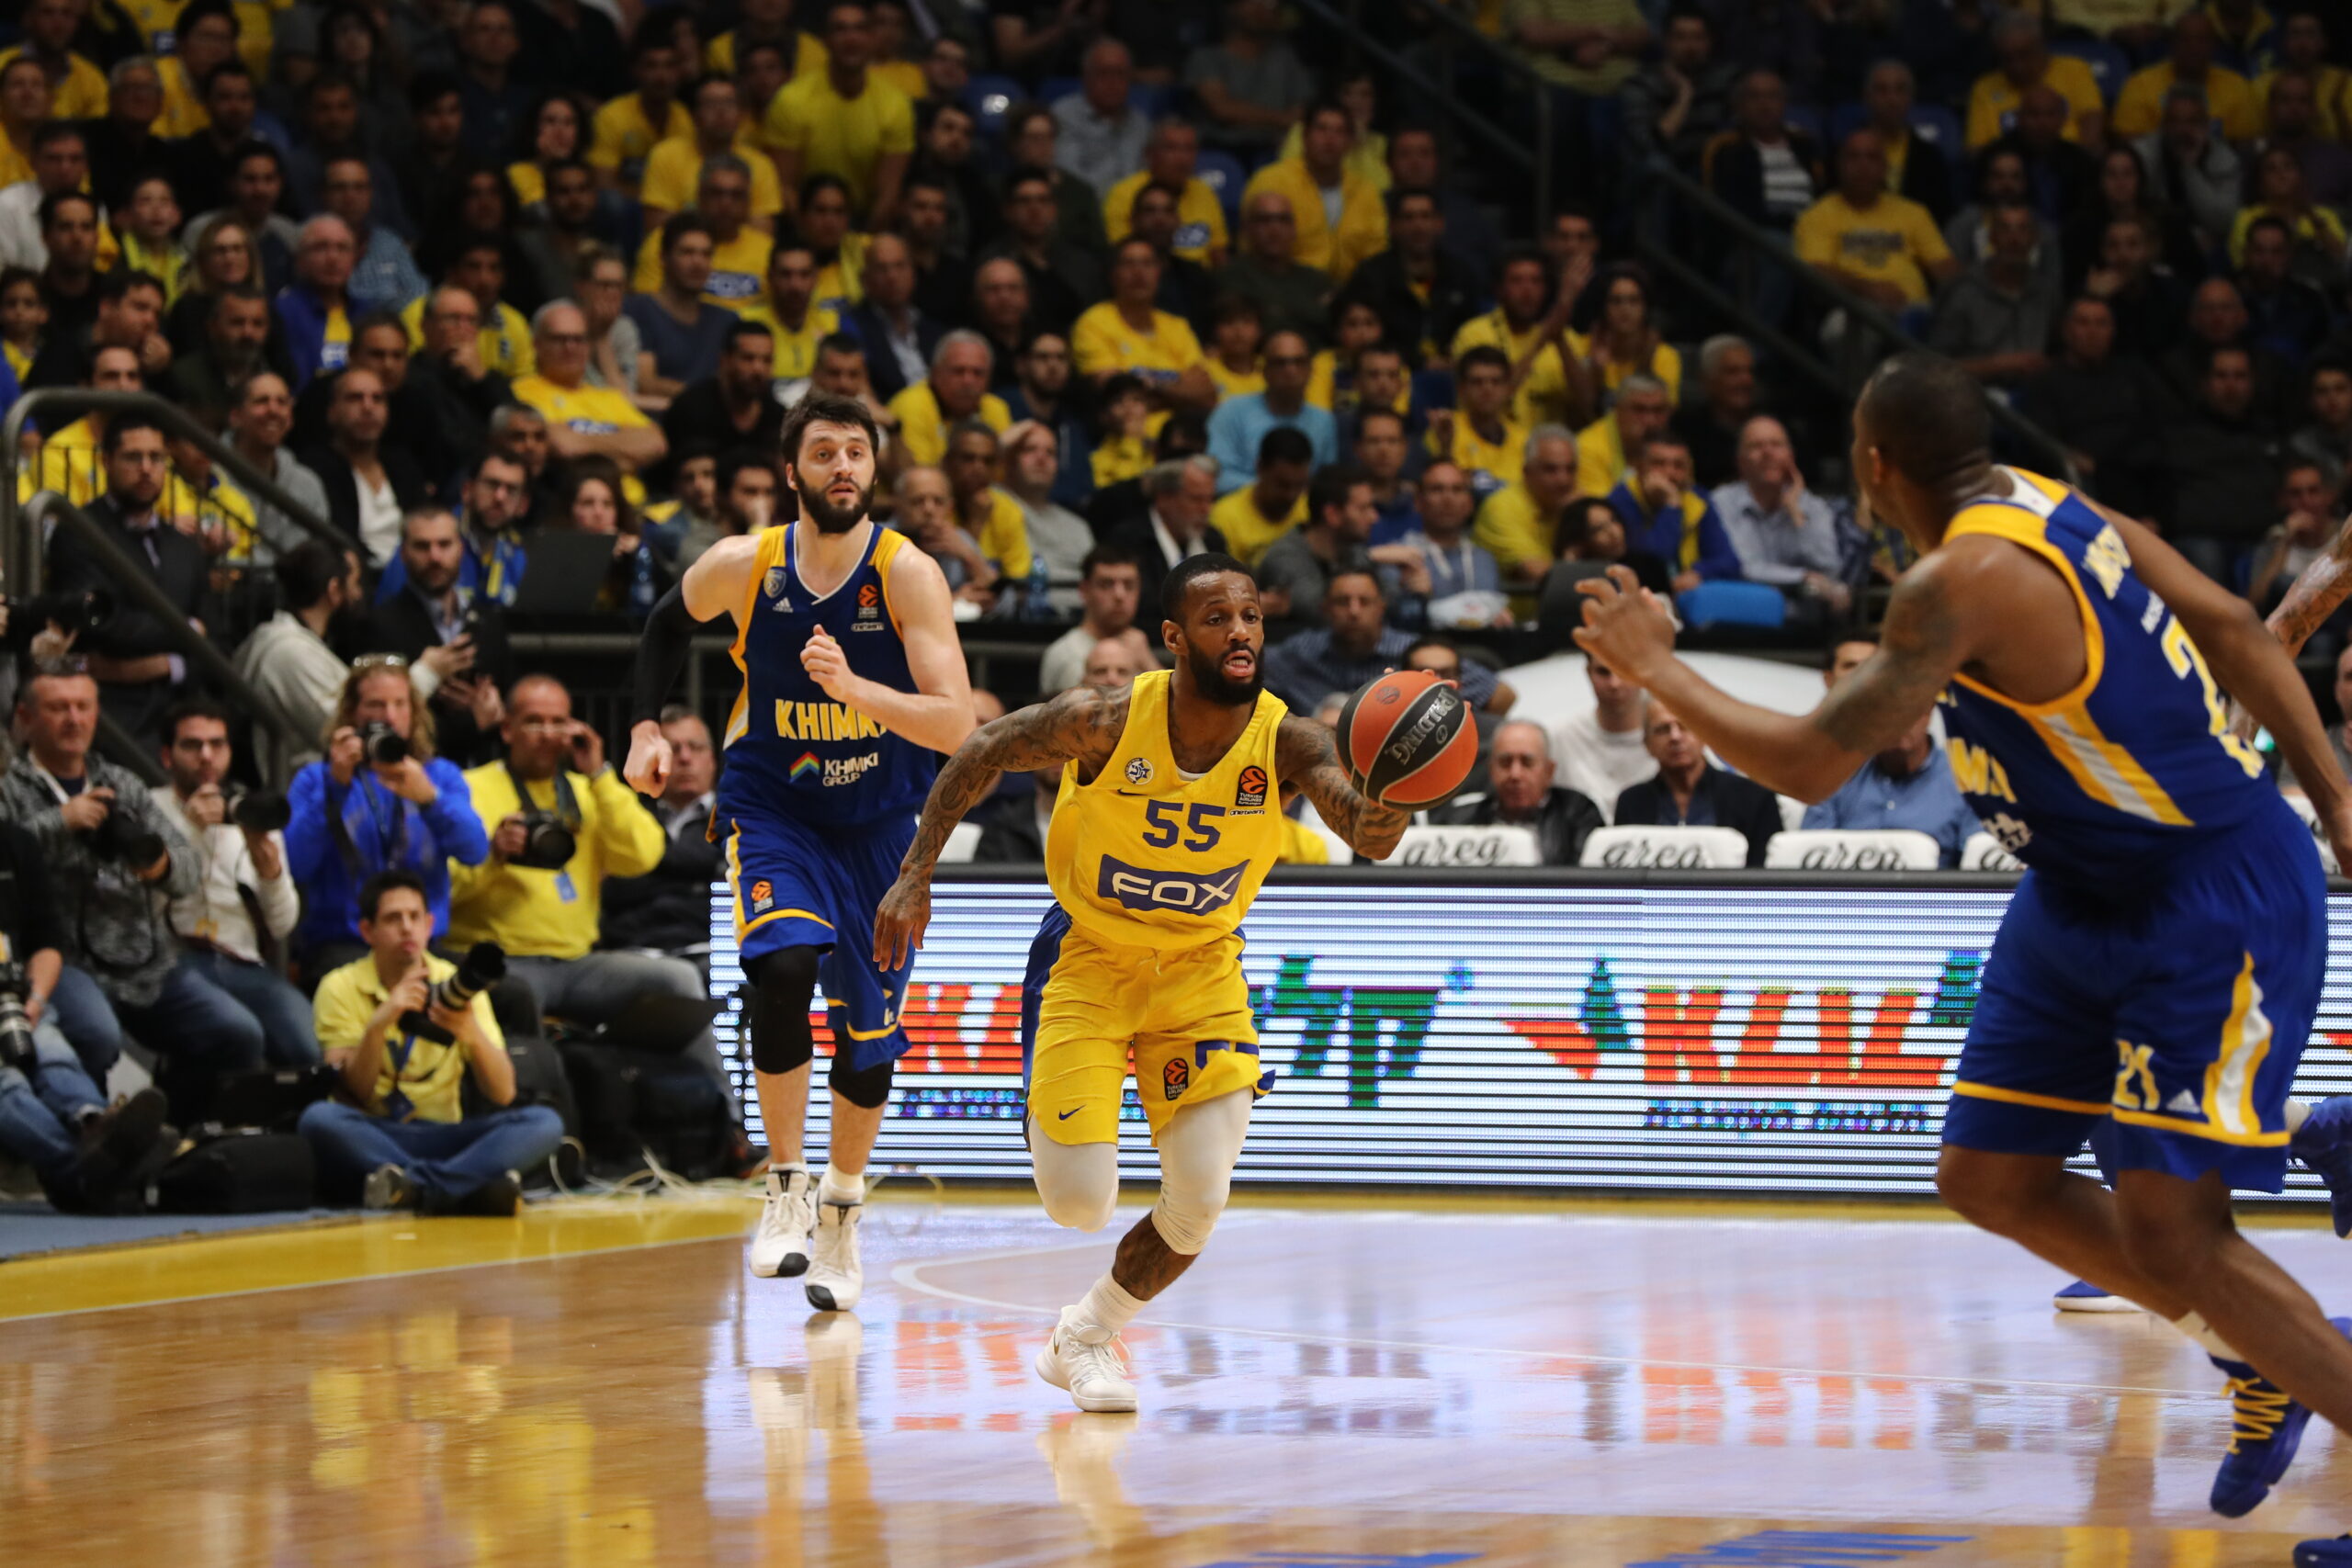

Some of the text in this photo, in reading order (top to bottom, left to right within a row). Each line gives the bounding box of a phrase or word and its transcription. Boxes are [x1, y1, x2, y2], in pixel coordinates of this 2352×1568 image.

[775, 698, 888, 741] KHIMK
[1384, 686, 1458, 765] PALDING
[822, 772, 861, 787] GROUP
[824, 751, 879, 776] KHIMKI
[1142, 798, 1227, 852] 55
[1112, 872, 1240, 910] FOX
[2112, 1038, 2161, 1111] 21
